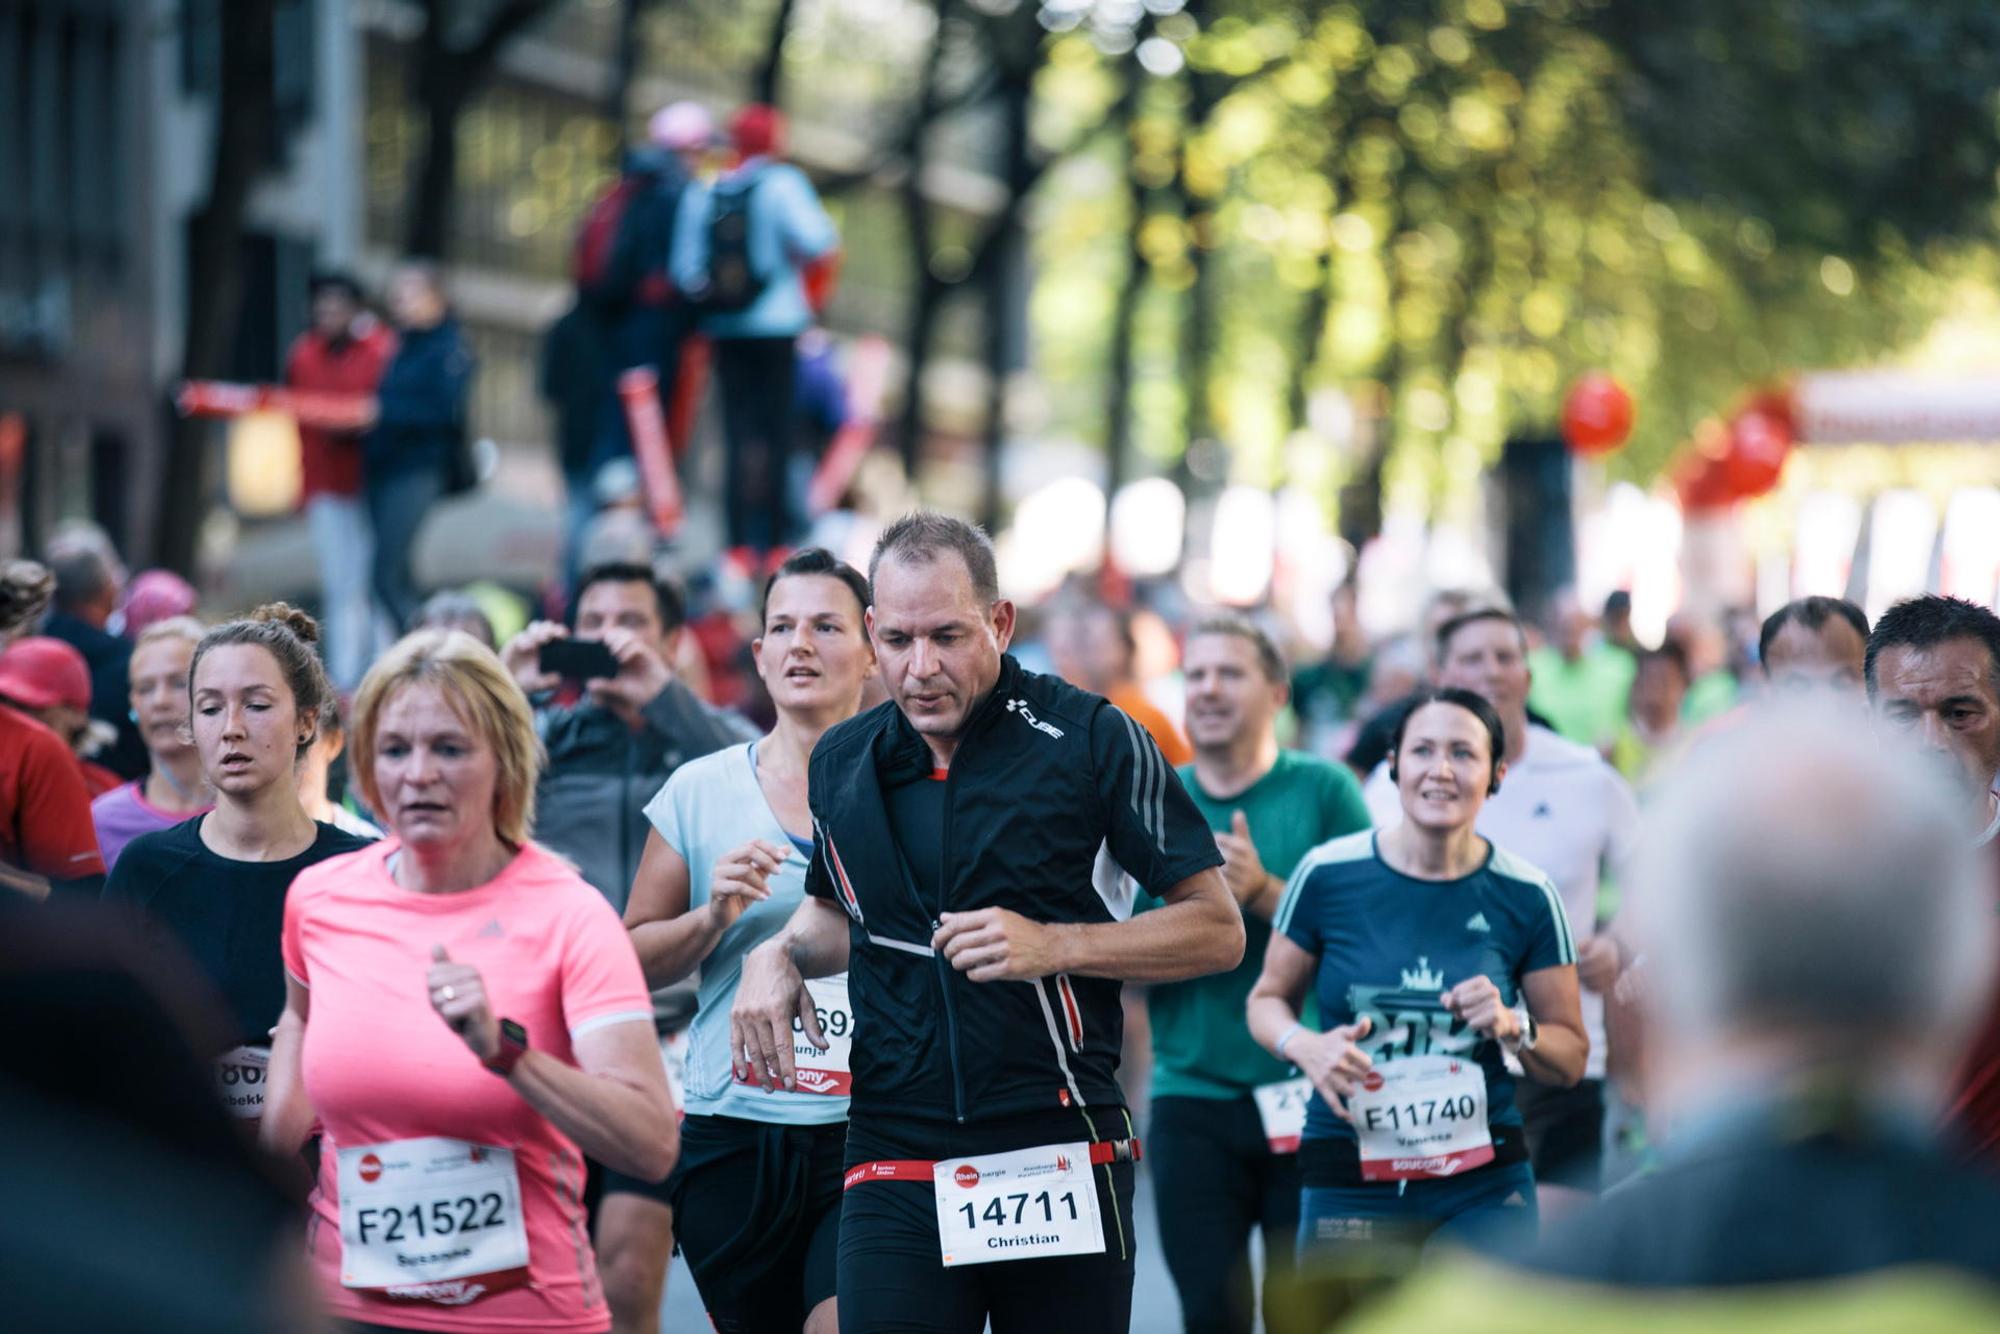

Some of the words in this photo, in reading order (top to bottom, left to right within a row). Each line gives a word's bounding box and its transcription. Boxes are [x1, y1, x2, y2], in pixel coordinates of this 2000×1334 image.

[1019, 707, 1065, 739] CUBE
[795, 1045, 827, 1058] unja
[1365, 1095, 1475, 1131] F11740
[358, 1193, 505, 1244] F21522
[958, 1191, 1078, 1229] 14711
[987, 1234, 1060, 1249] Christian
